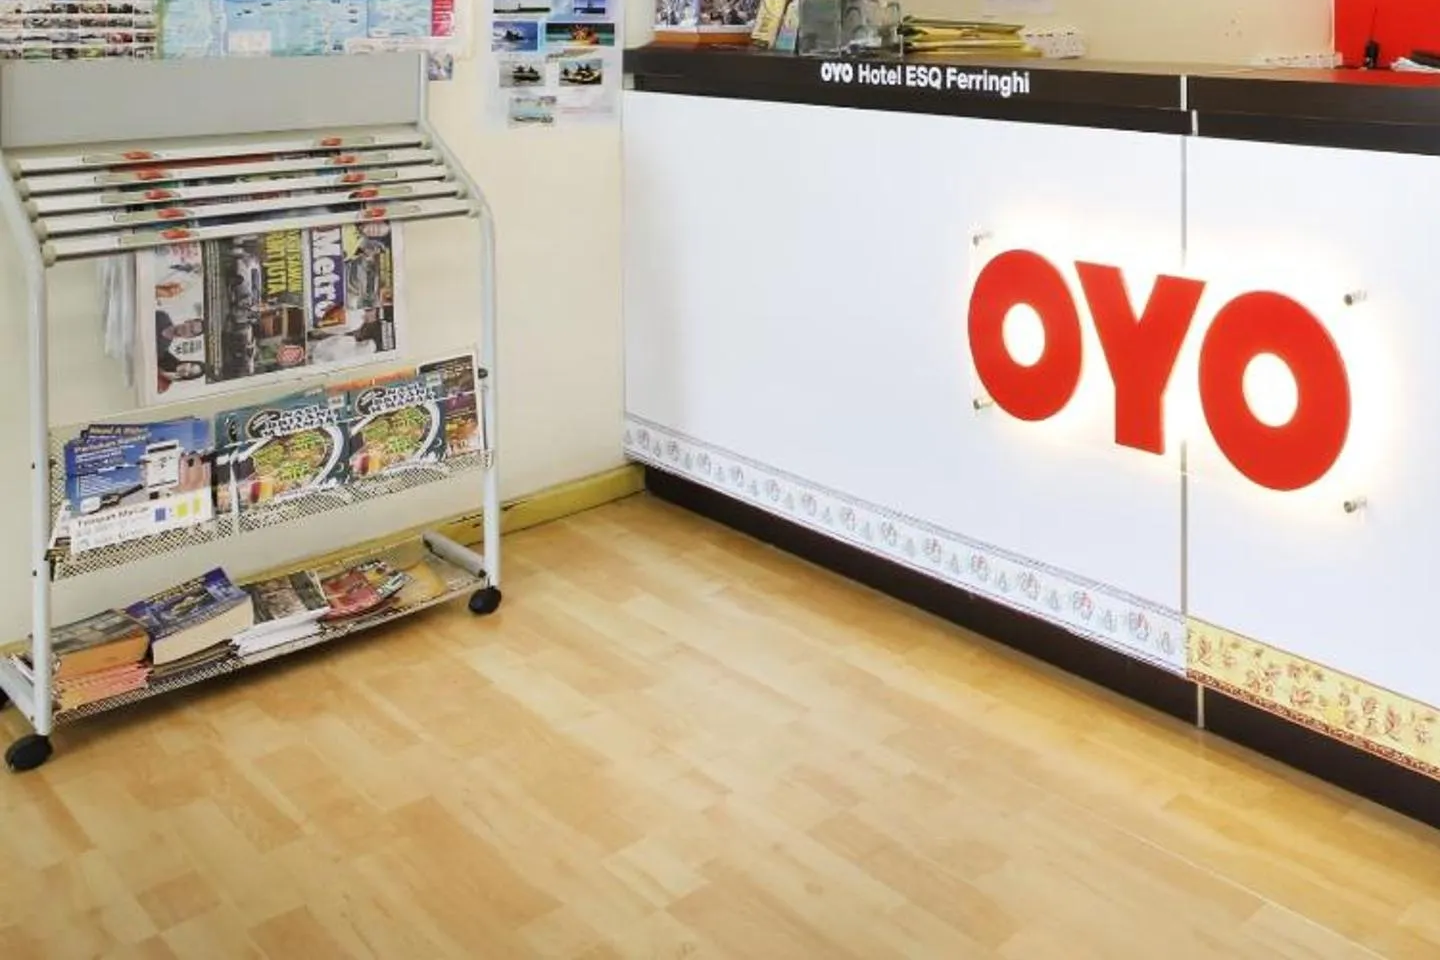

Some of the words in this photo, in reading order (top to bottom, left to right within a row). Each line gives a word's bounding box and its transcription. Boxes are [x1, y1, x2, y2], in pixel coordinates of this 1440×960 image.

[821, 62, 853, 83] OYO
[858, 63, 901, 86] Hotel
[906, 66, 942, 90] ESQ
[946, 68, 1030, 98] Ferringhi
[968, 249, 1352, 492] OYO
